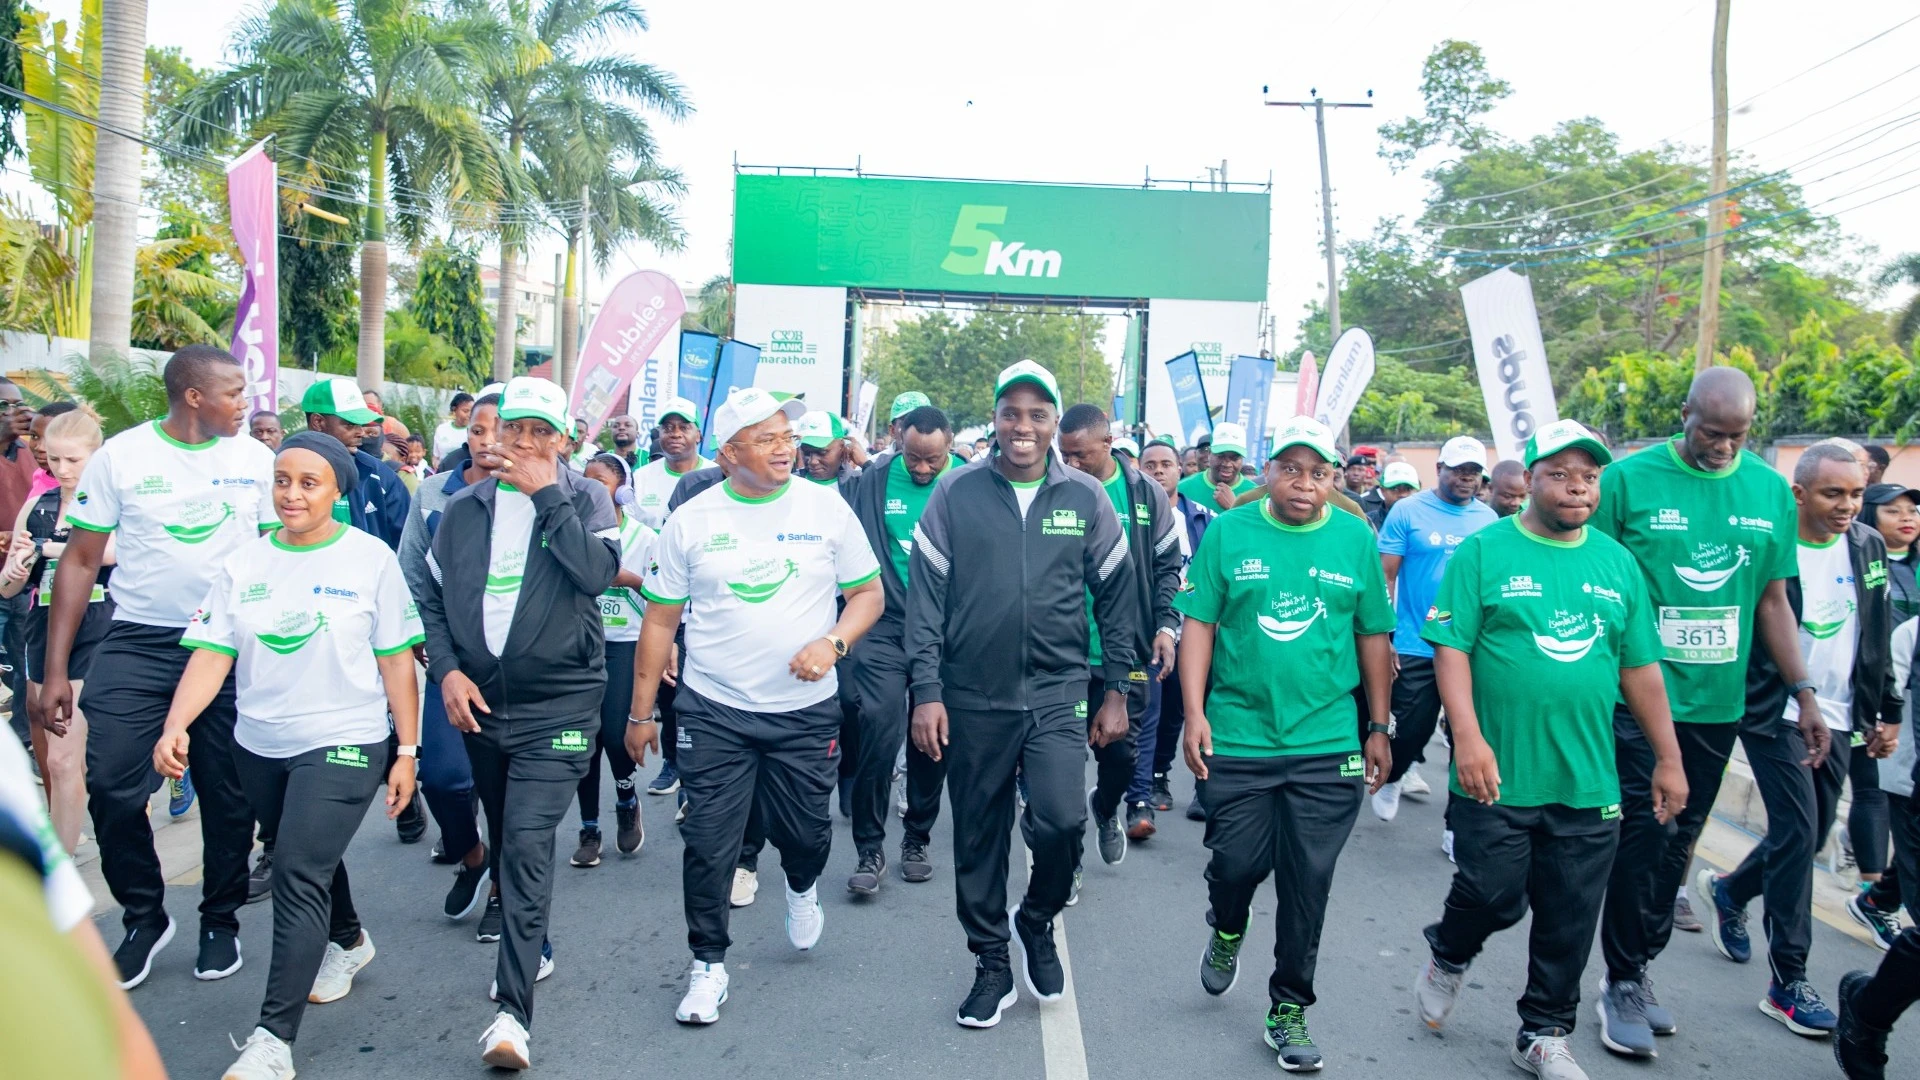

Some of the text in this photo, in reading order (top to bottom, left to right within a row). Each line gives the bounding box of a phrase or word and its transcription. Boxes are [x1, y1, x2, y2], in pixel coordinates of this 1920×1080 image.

[600, 295, 666, 367] Jubilee
[771, 329, 804, 341] CRDB
[771, 341, 803, 352] BANK
[757, 355, 817, 365] marathon
[1326, 340, 1363, 411] Sanlam
[223, 477, 255, 485] Sanlam
[1052, 509, 1078, 518] CRDB
[1649, 523, 1689, 531] marathon
[1739, 516, 1774, 530] Sanlam
[787, 533, 823, 541] Sanlam
[704, 545, 738, 553] marathon
[1235, 573, 1270, 581] marathon
[1319, 569, 1354, 585] Sanlam
[324, 586, 360, 599] Sanlam
[1501, 590, 1543, 598] marathon
[1676, 629, 1727, 646] 3613
[1683, 650, 1722, 659] 10 KM
